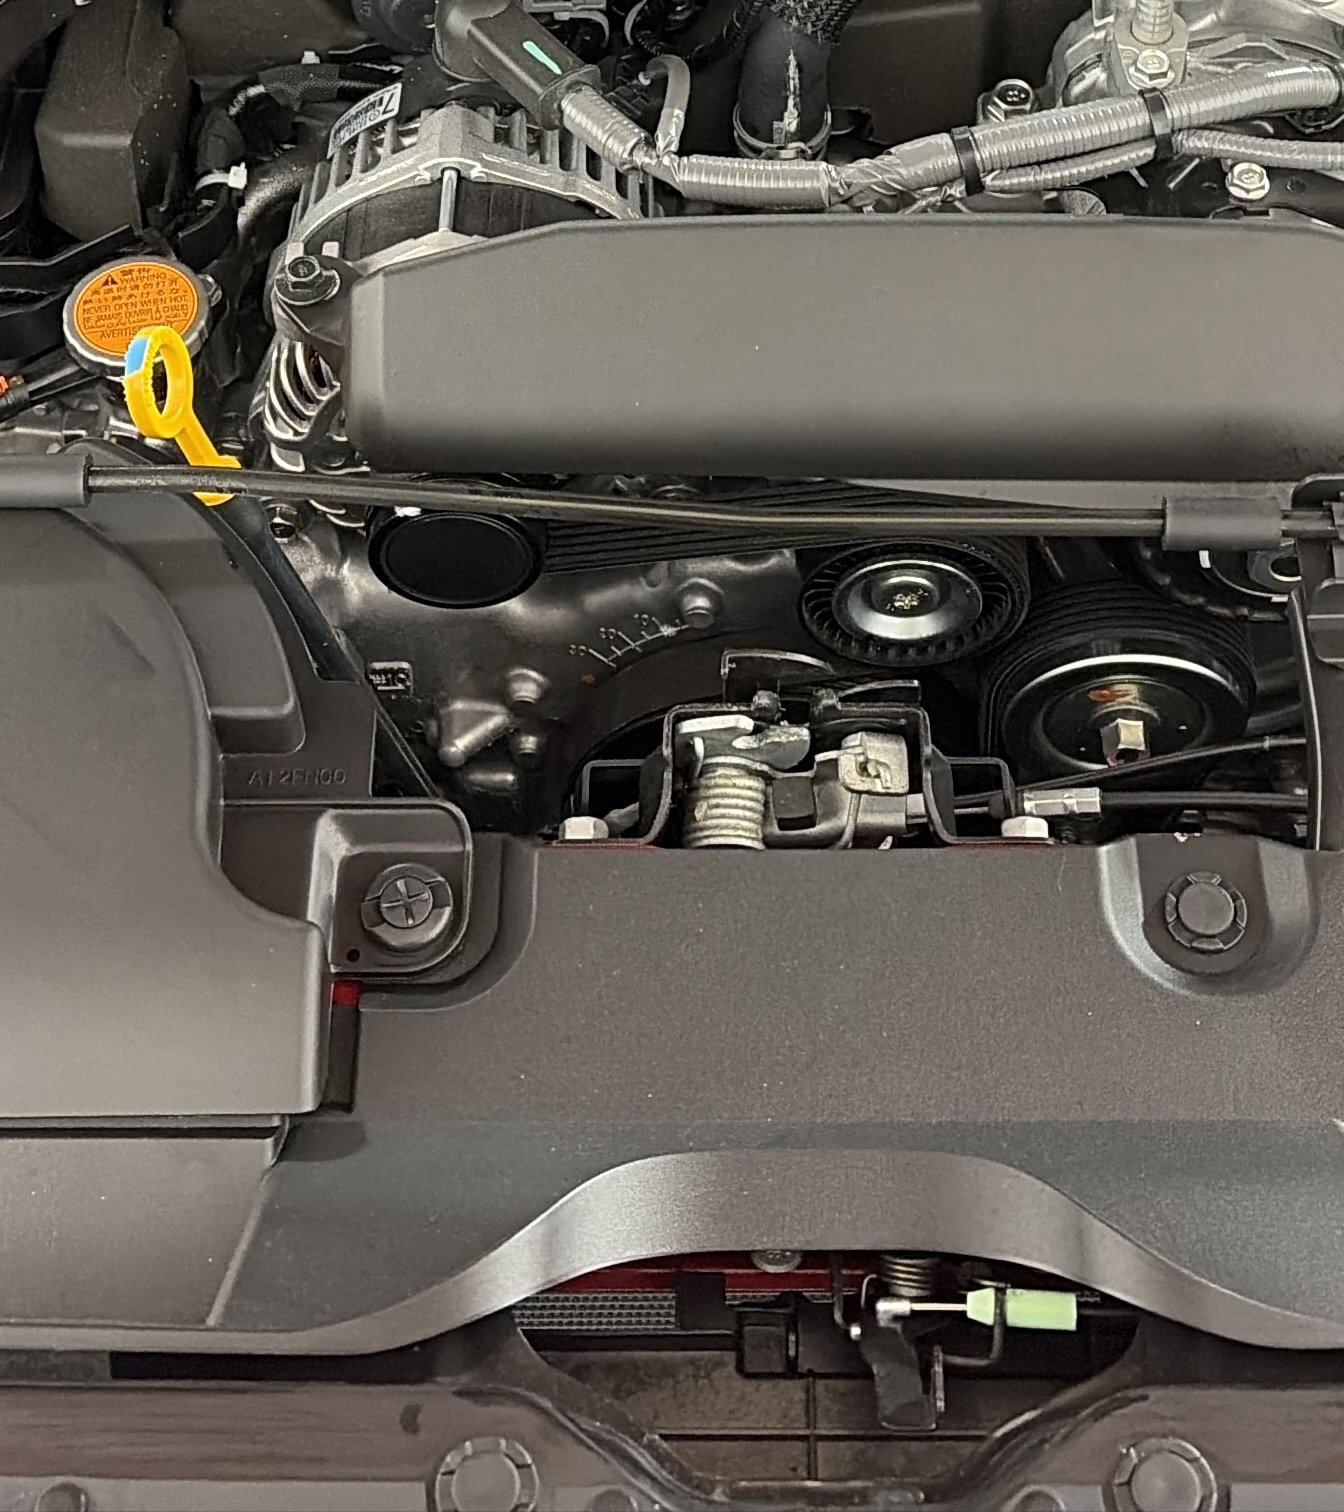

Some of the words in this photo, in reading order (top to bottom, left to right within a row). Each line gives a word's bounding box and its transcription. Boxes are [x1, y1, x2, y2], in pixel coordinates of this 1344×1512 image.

[120, 272, 167, 284] WARNING
[82, 303, 111, 316] NEVER
[114, 300, 137, 311] OPEN
[140, 296, 167, 308] WHEN
